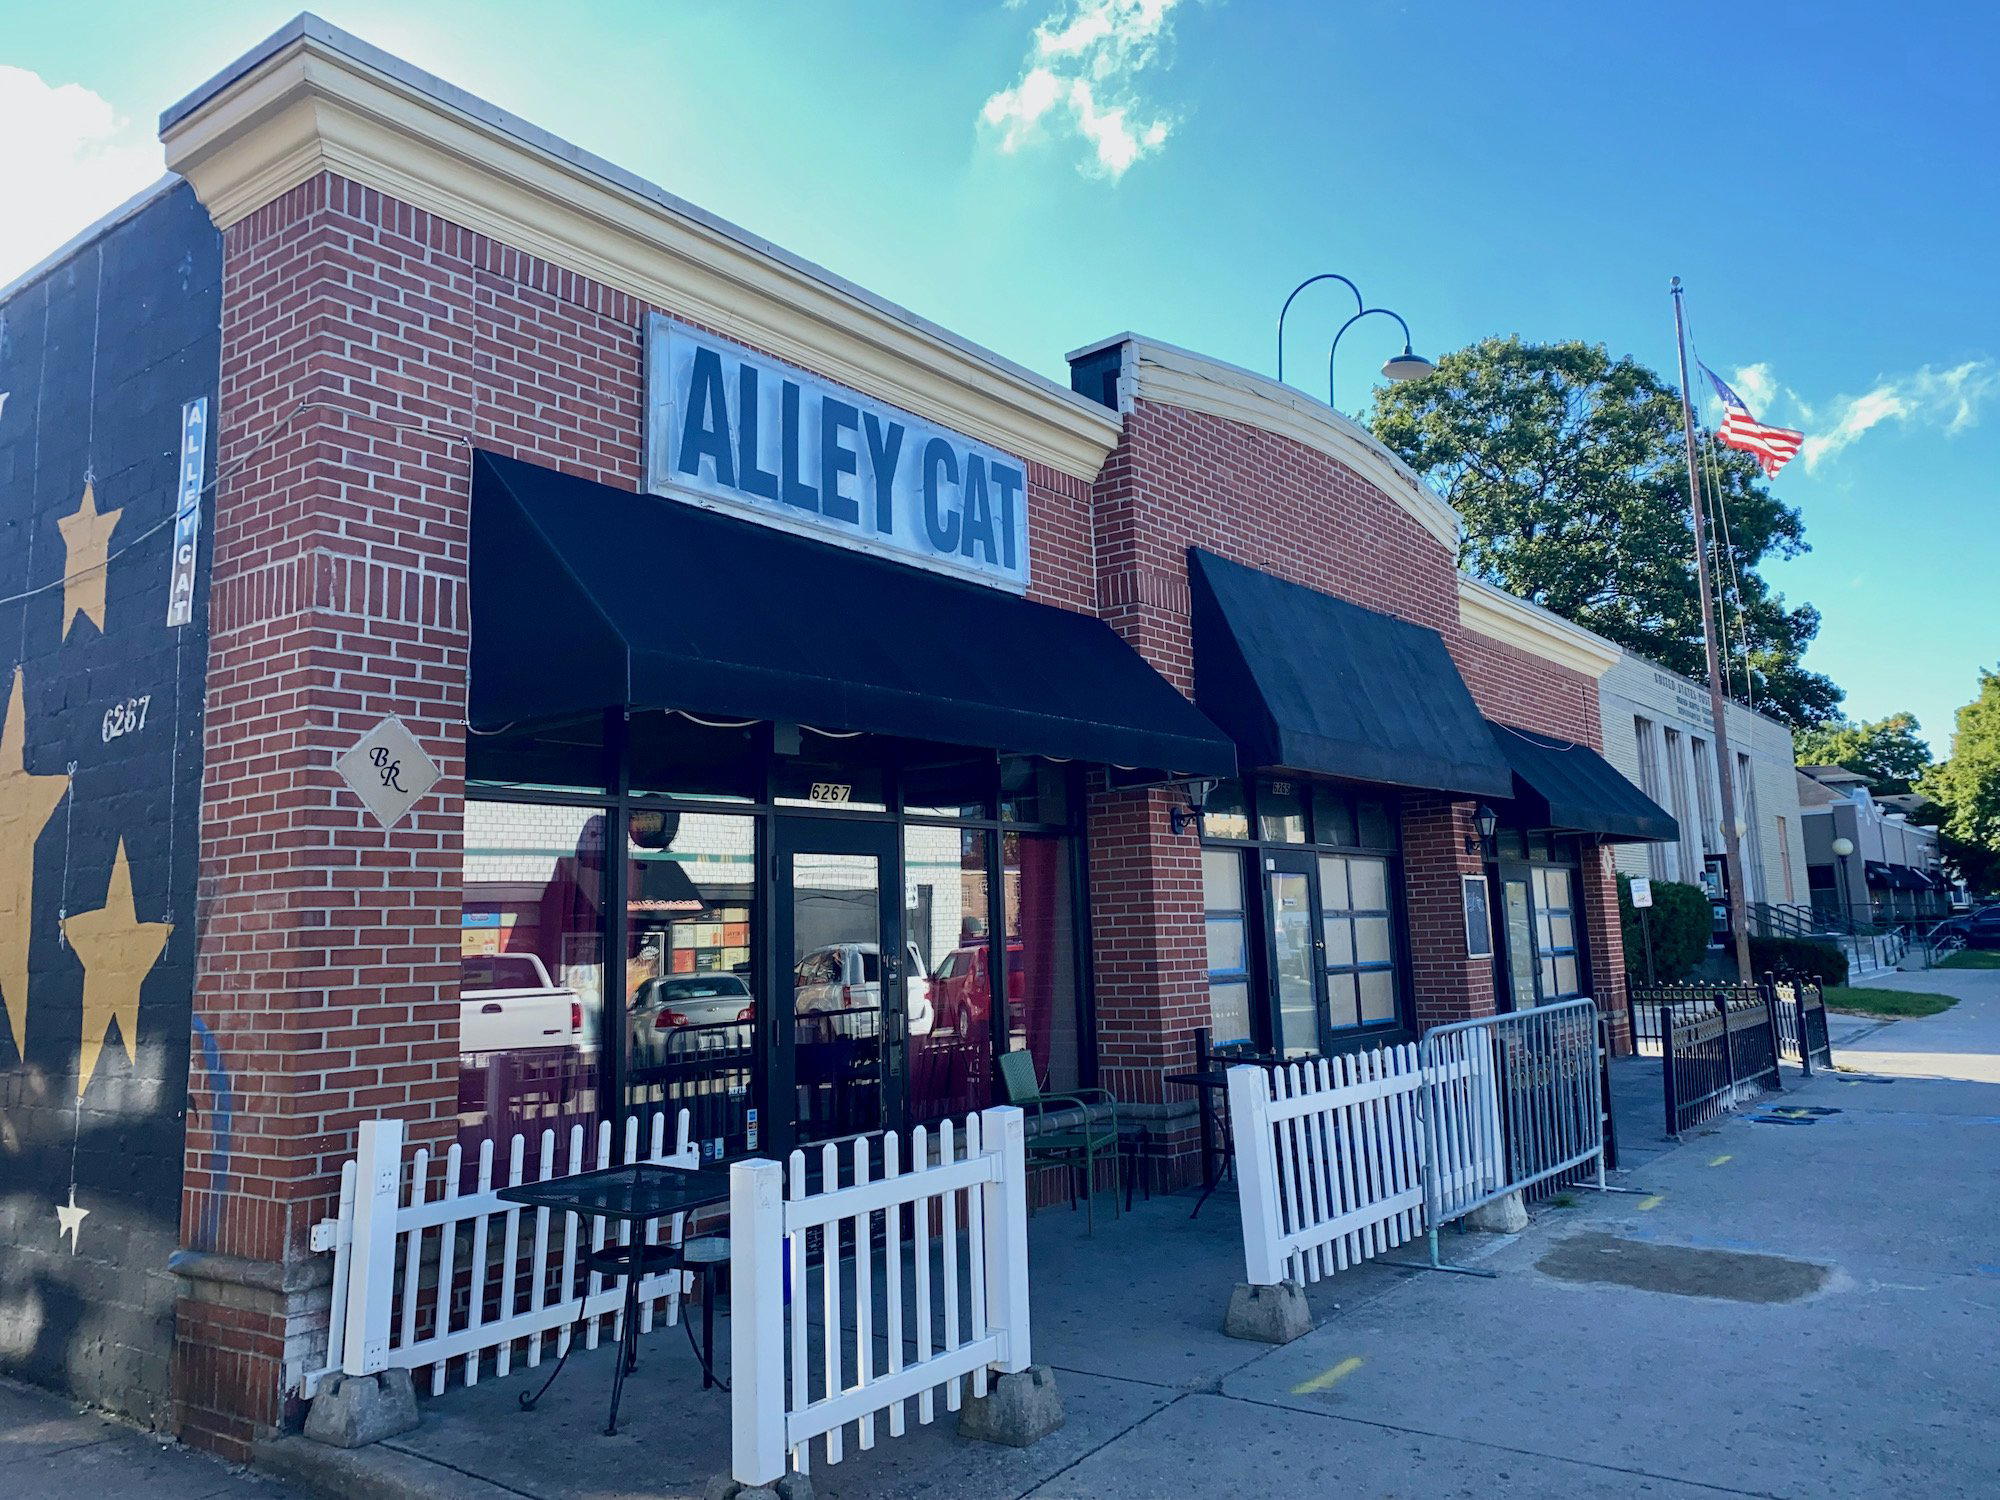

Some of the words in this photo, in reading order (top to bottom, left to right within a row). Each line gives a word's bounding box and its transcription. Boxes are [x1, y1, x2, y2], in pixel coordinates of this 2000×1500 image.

[678, 345, 905, 535] ALLEY
[923, 437, 1022, 571] CAT
[102, 695, 151, 742] 6267
[812, 784, 850, 800] 6267
